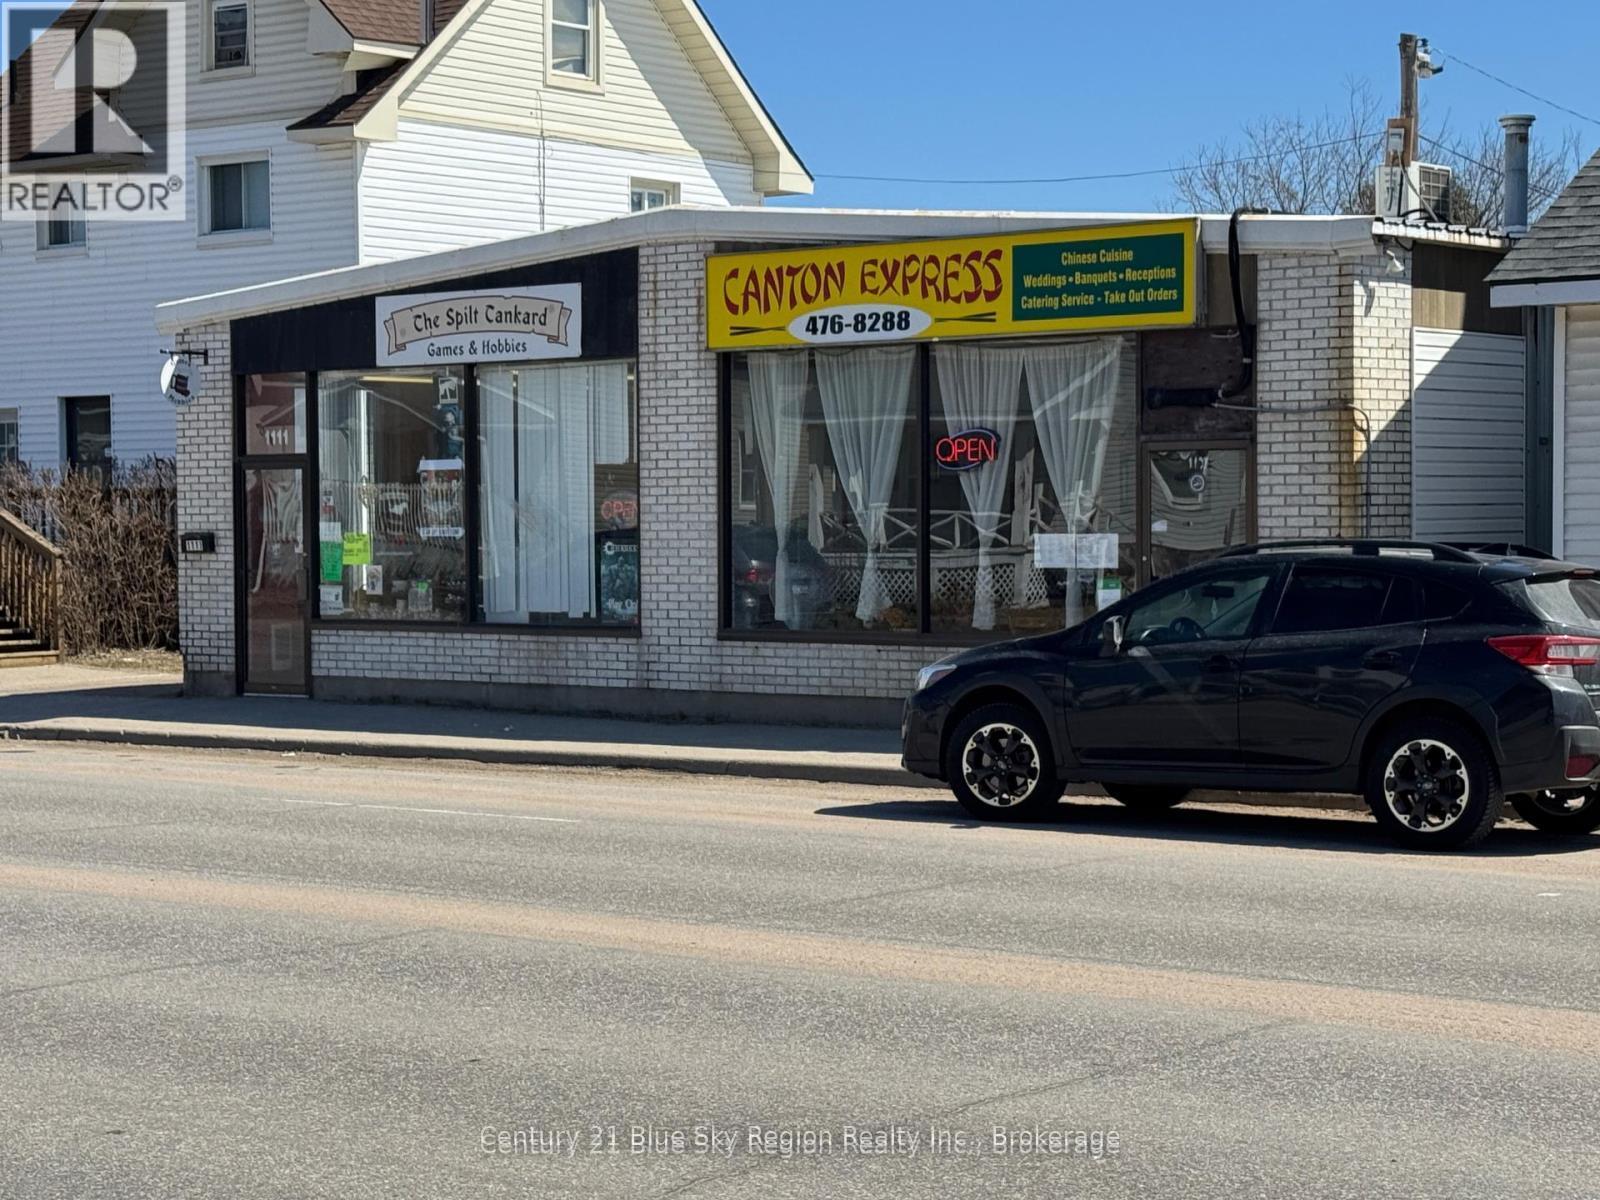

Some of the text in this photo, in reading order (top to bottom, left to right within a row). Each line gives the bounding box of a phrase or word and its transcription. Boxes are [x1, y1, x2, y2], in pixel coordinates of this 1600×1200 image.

[1061, 248, 1133, 266] Chinese Cuisine
[723, 248, 1004, 316] CANTON EXPRESS
[1023, 266, 1177, 289] Weddings Banquets Receptions
[1021, 294, 1059, 310] Catering
[1061, 292, 1095, 307] Service
[1104, 289, 1126, 304] Take
[1128, 288, 1145, 303] Out
[1147, 287, 1178, 301] Orders
[413, 304, 548, 332] The Spilt Tankard
[805, 310, 911, 336] 476-8288
[427, 338, 527, 358] Games & Hobbies
[264, 429, 289, 446] 1111
[936, 438, 996, 462] OPEN
